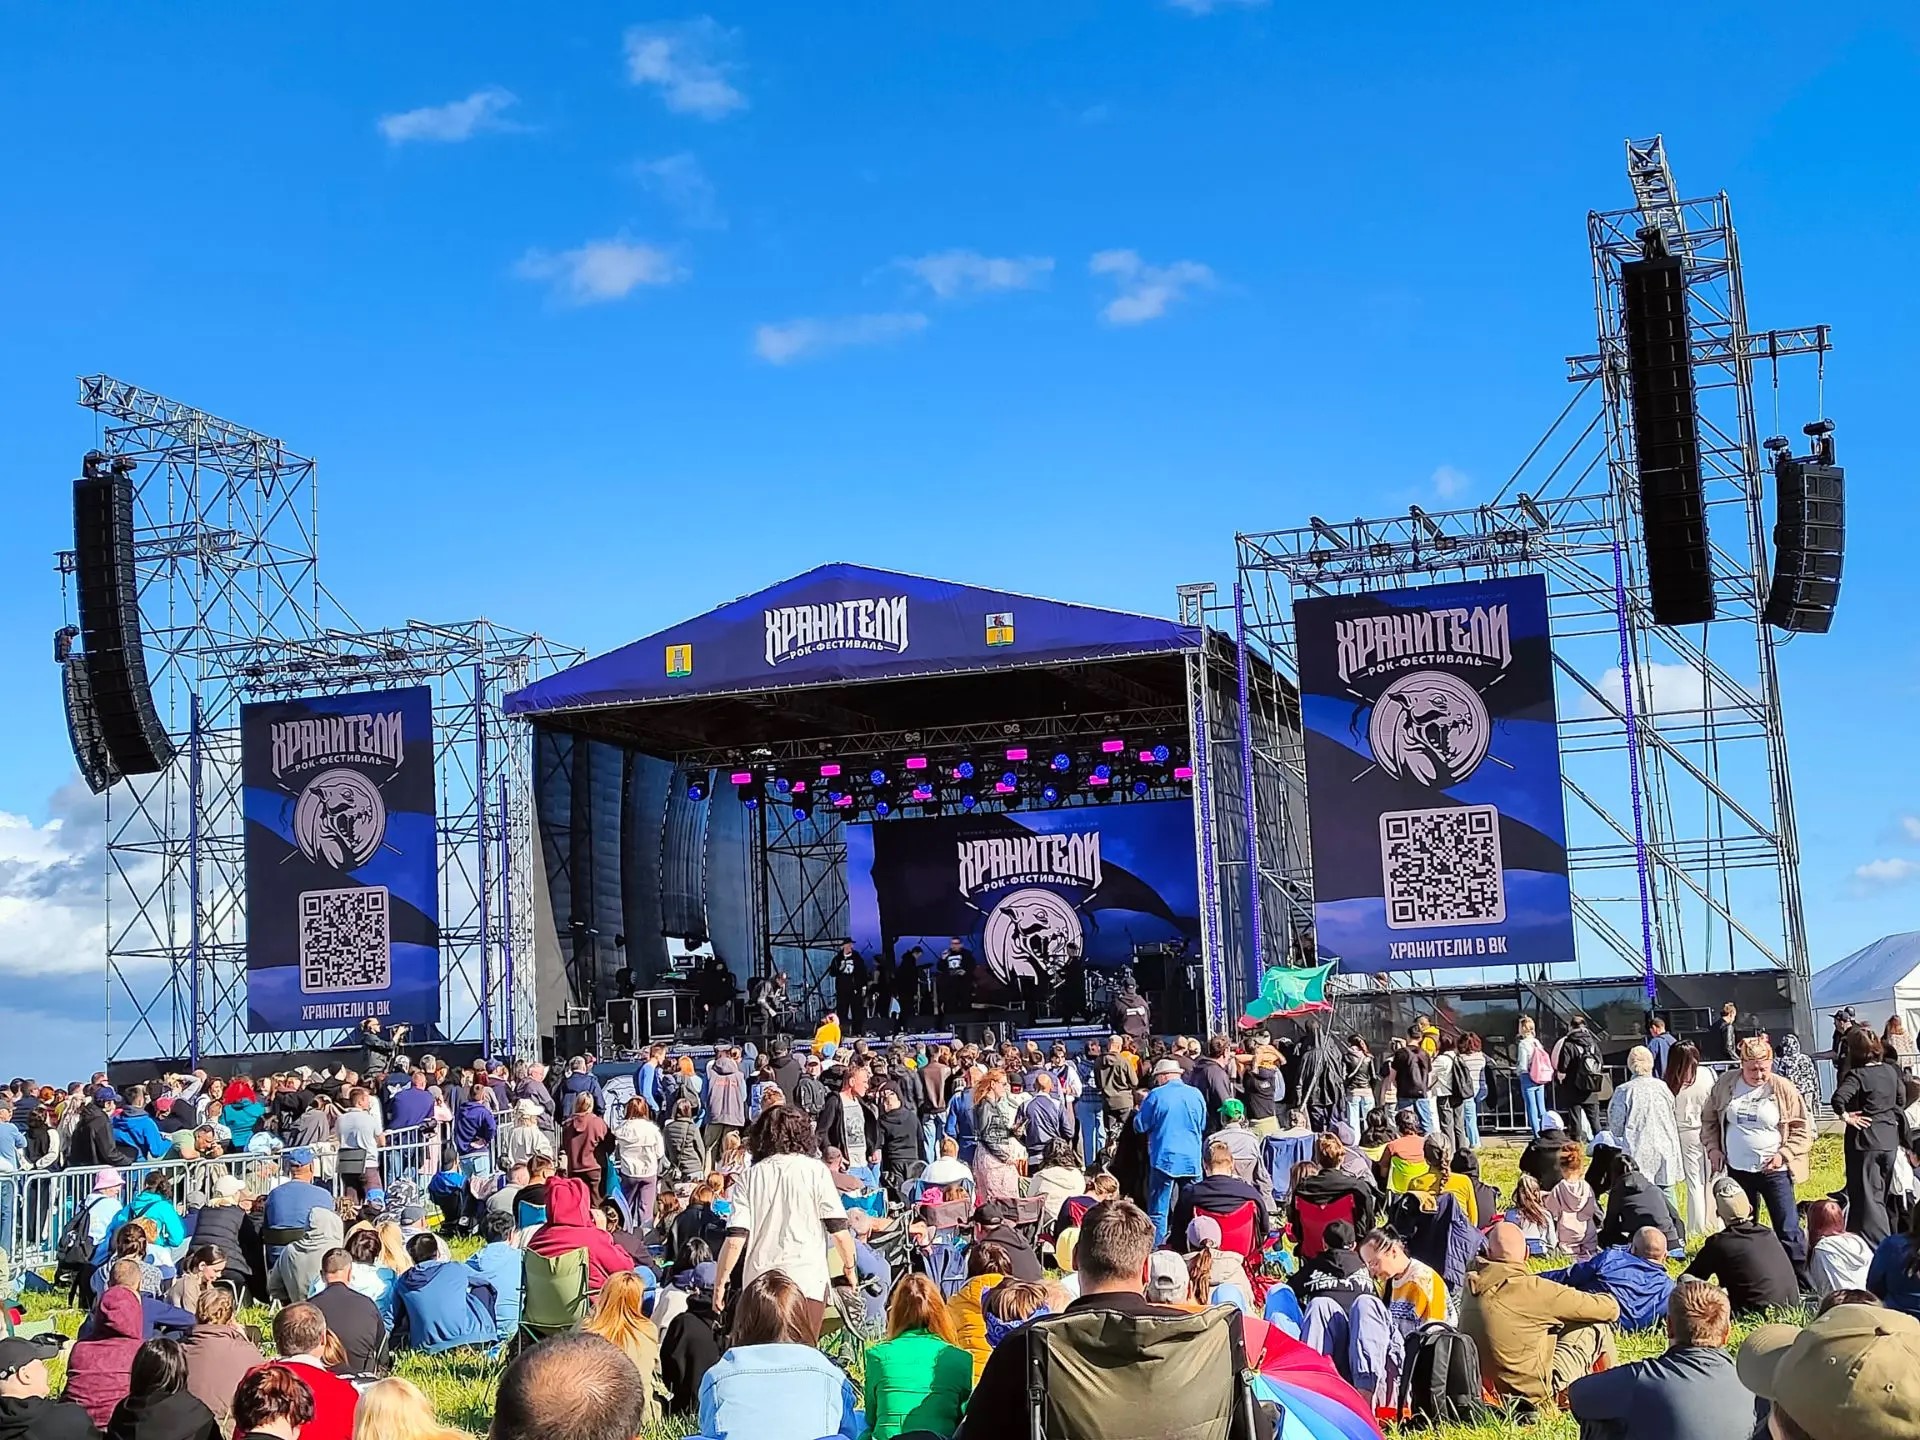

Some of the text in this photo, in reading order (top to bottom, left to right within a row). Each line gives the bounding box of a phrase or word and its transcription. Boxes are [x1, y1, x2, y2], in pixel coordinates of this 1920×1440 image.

[764, 595, 909, 667] ХРАНИТЕЛИ
[790, 639, 884, 660] РОК-ФЕСТИВАЛЬ
[1335, 603, 1513, 684] ХРАНИТЕЛИ
[1368, 654, 1483, 676] РОК-ФЕСТИВАЛЬ
[271, 711, 404, 779] ХРАНИТЕЛИ
[294, 754, 382, 773] РОК-ФЕСТИВАЛЬ
[957, 831, 1103, 898] ХРАНИТЕЛИ
[983, 874, 1078, 892] РОК-ФЕСТИВАЛЬ
[1390, 936, 1507, 960] ХРАНИТЕЛИ В ВК
[302, 1000, 391, 1020] ХРАНИТЕЛИ В ВК
